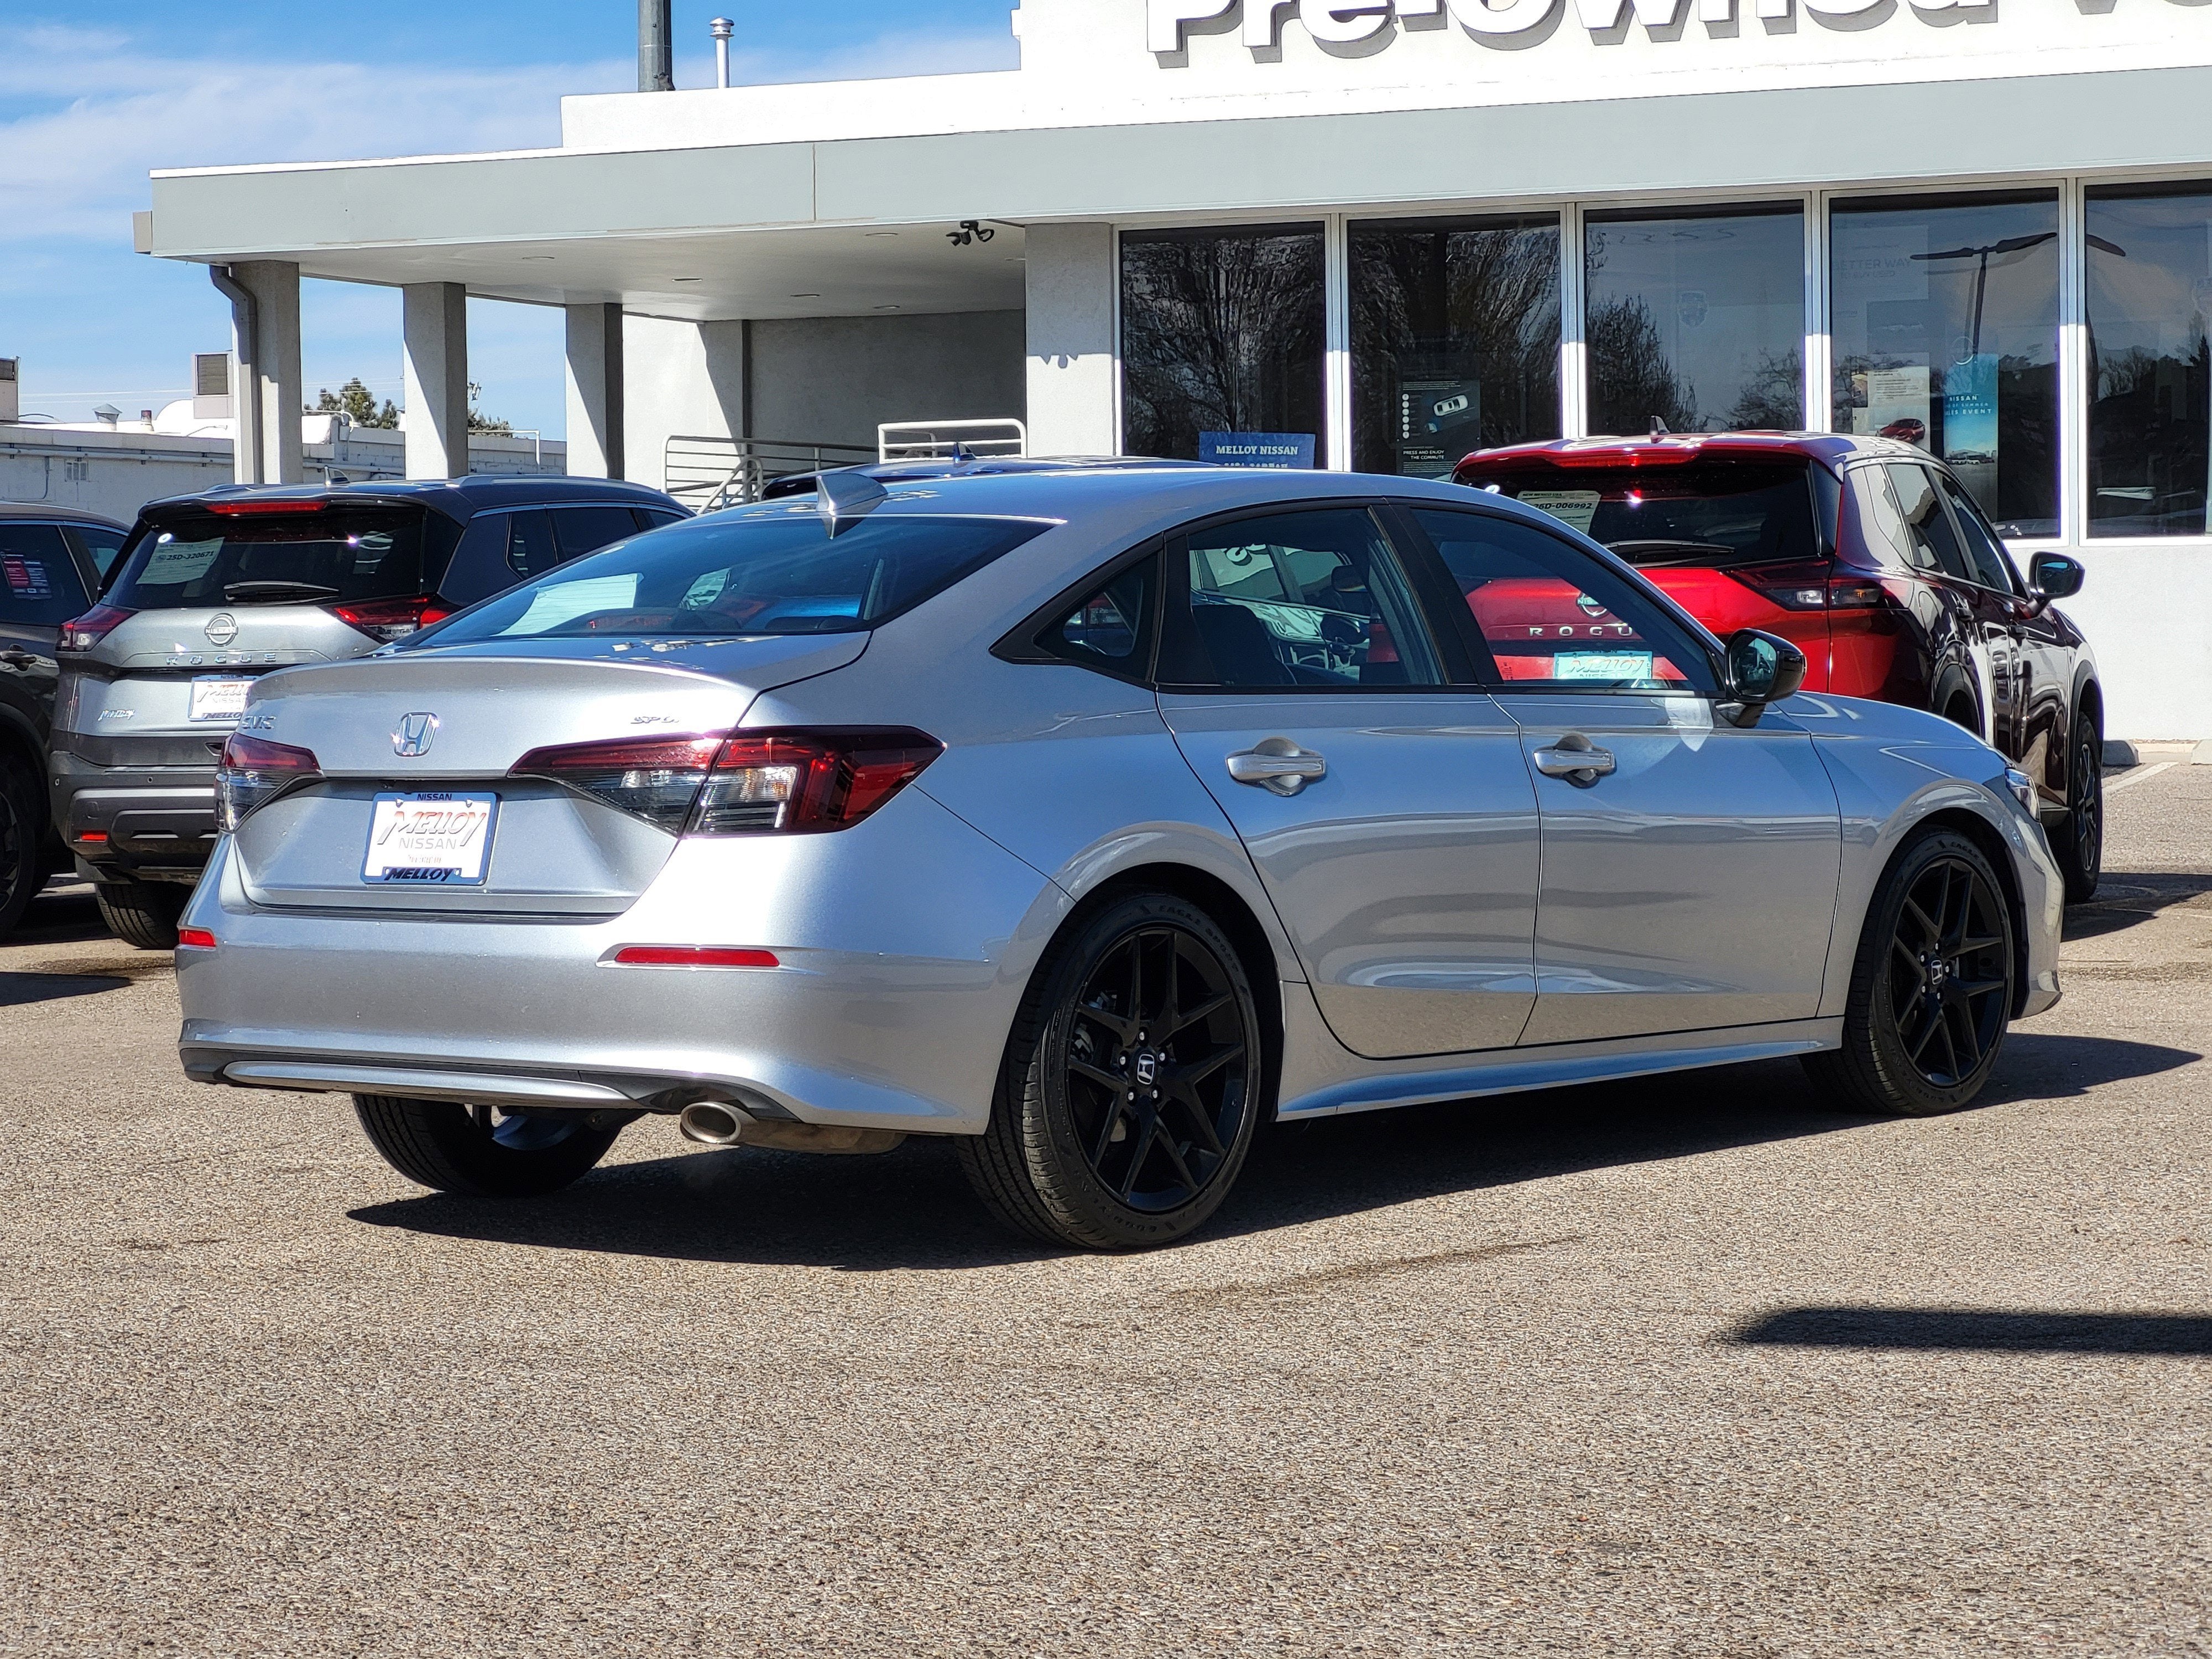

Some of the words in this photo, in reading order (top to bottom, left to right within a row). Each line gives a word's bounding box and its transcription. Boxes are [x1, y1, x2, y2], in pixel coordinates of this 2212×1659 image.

[1834, 258, 1881, 271] ETTER
[1215, 445, 1258, 455] MELLOY
[1260, 446, 1298, 455] NISSAN
[1529, 625, 1633, 637] ROGU
[166, 653, 276, 665] ROGUE
[197, 684, 251, 702] MELL
[416, 793, 452, 801] NISSAN
[377, 811, 487, 847] MELLOY
[399, 837, 457, 849] NISSAN
[383, 867, 455, 882] MELLOY
